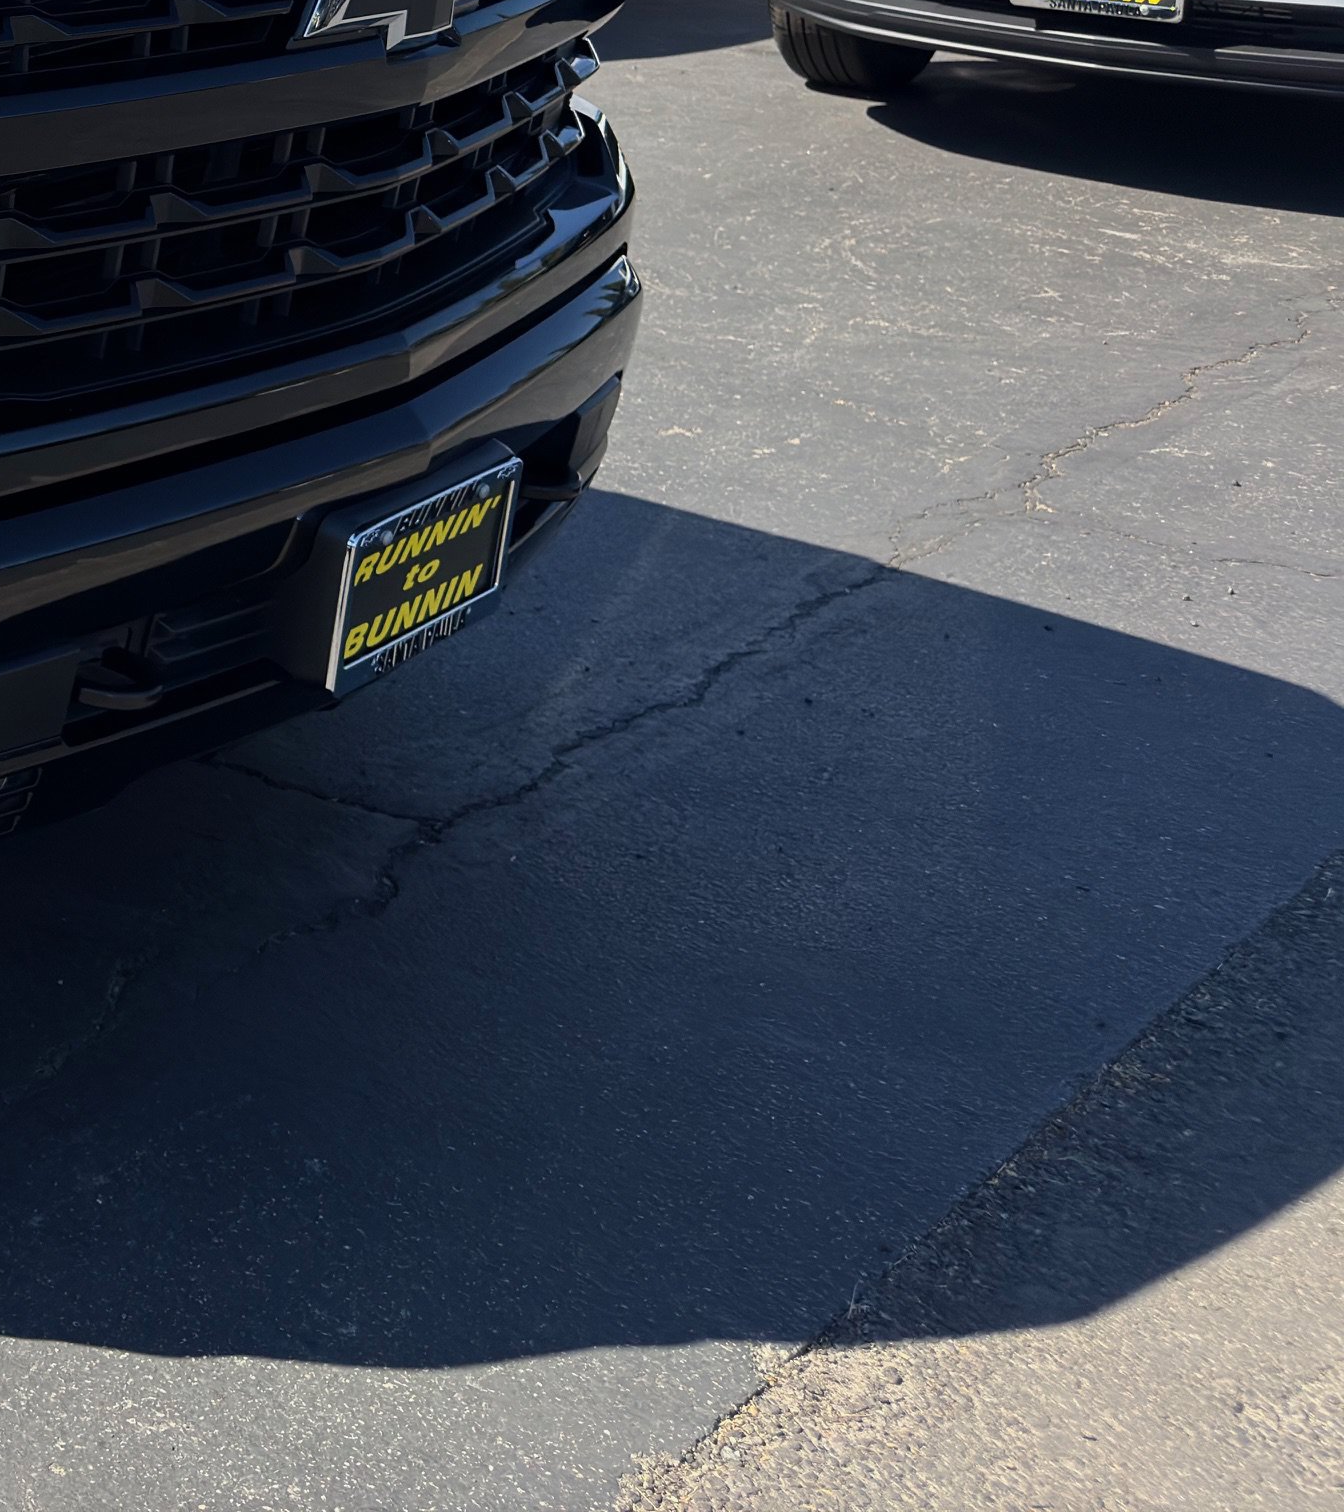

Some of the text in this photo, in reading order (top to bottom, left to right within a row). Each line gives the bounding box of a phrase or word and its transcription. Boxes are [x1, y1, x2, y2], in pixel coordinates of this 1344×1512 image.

[353, 494, 503, 588] RUNNIN'
[402, 559, 441, 591] to
[343, 563, 485, 661] BUNNIN
